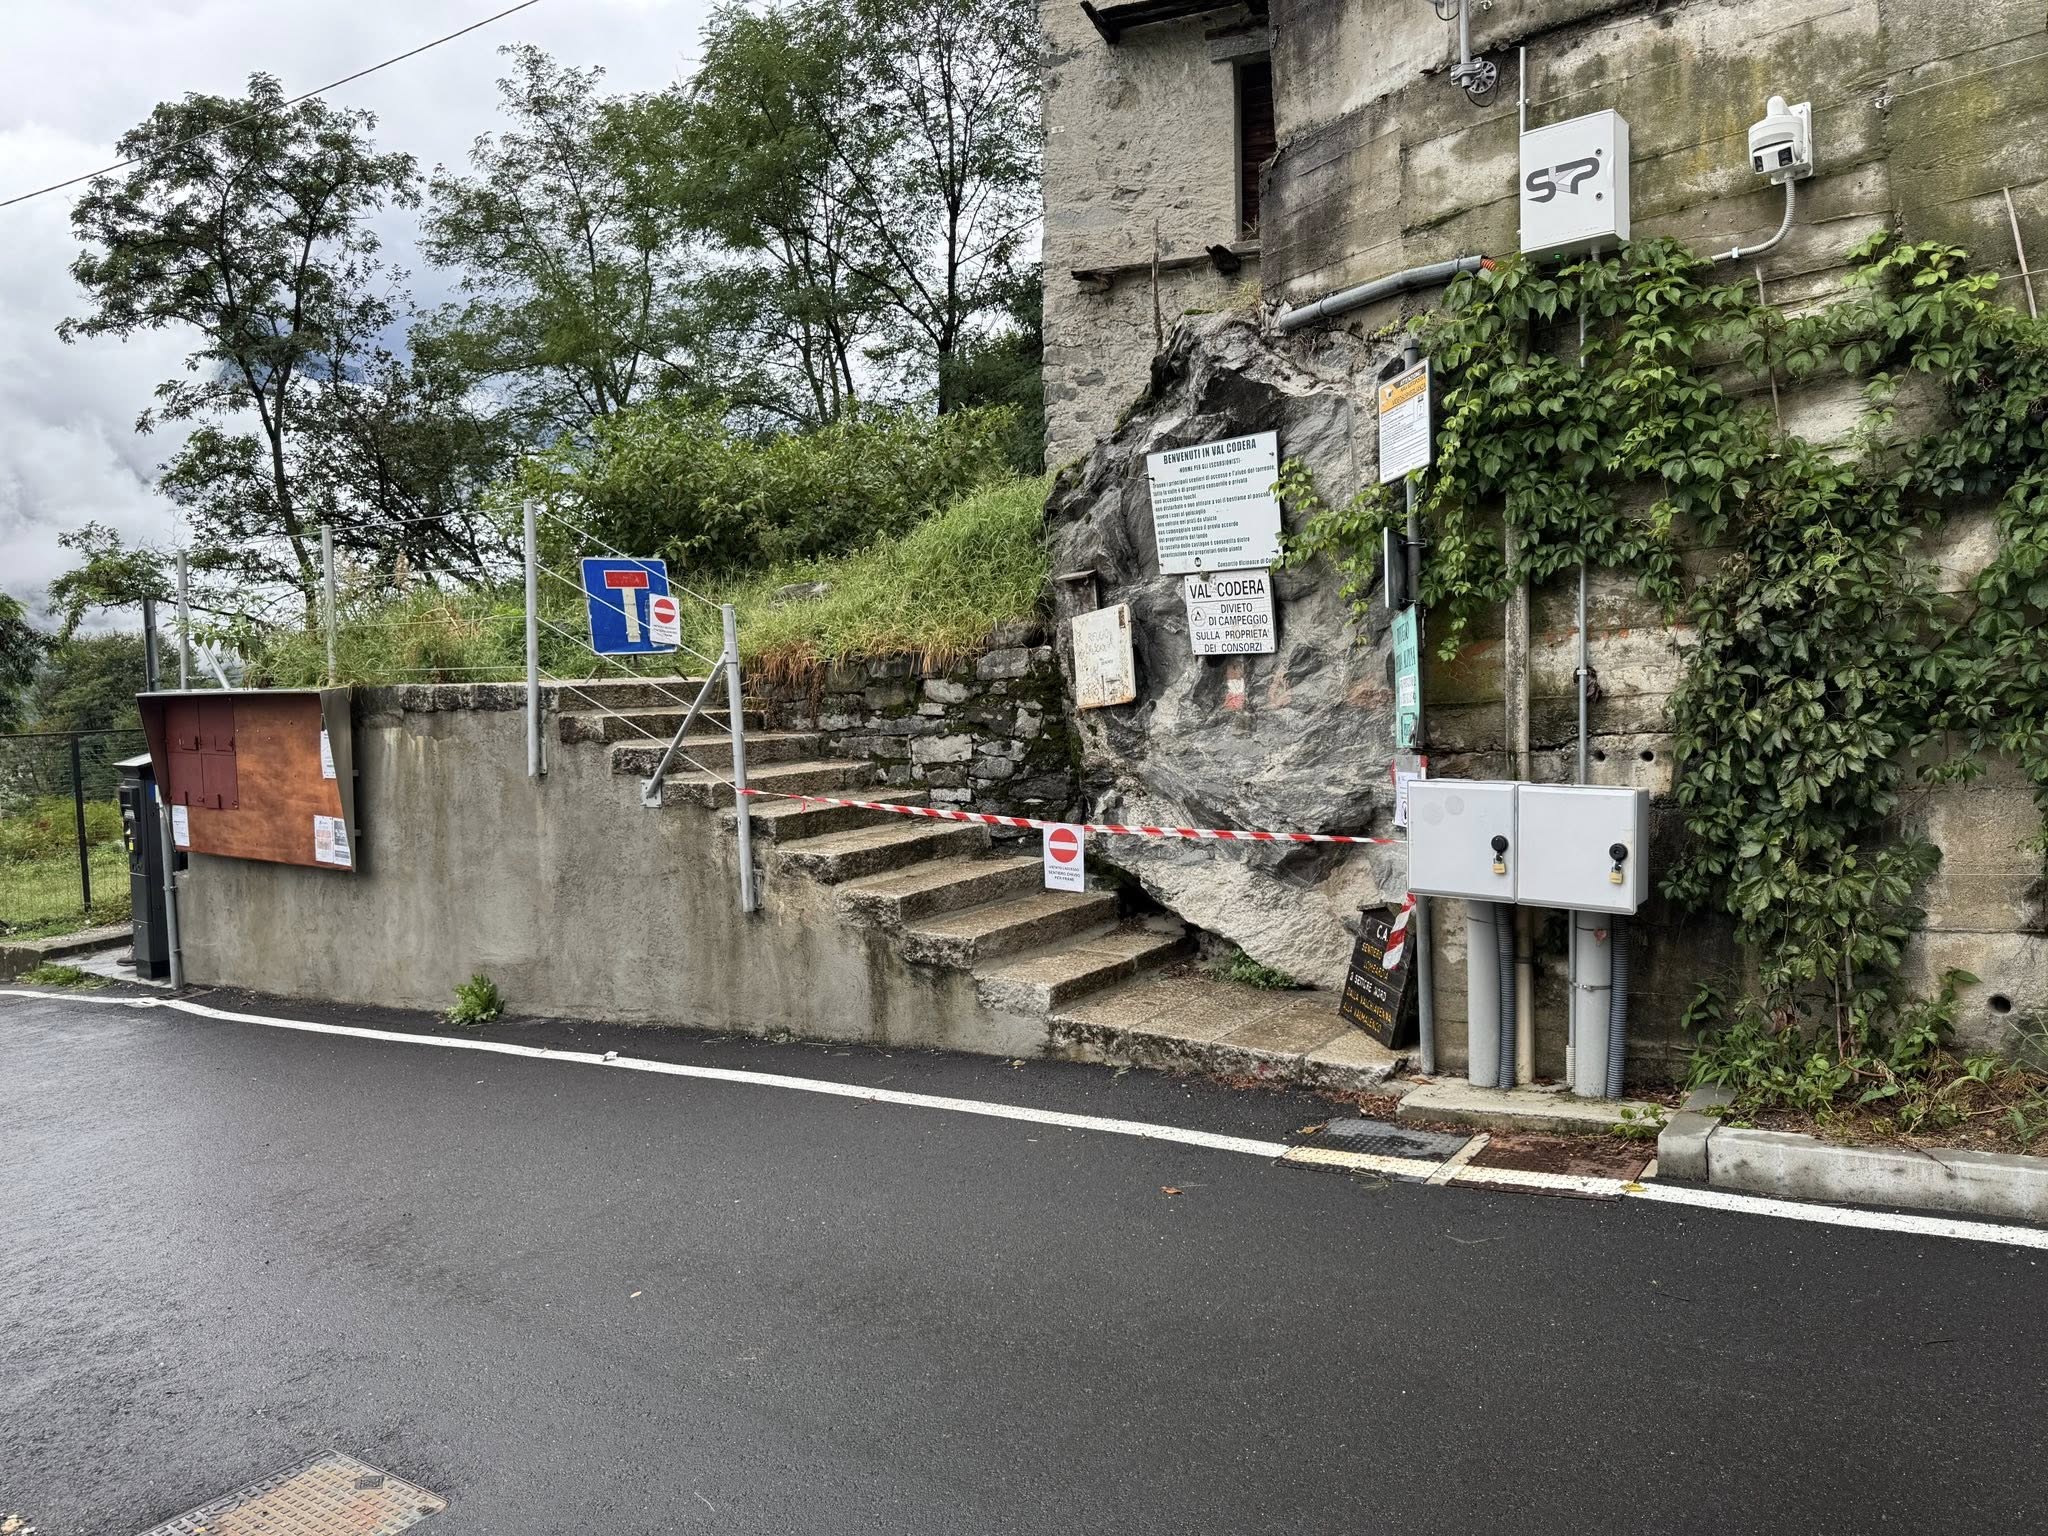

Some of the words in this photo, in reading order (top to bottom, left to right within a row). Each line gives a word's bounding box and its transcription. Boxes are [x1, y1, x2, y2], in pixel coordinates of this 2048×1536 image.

[1163, 449, 1200, 464] BENVENUTI
[1202, 447, 1210, 457] IN
[1212, 445, 1224, 455] VAL
[1226, 439, 1256, 453] CODERA
[1190, 584, 1211, 598] VAL
[1218, 579, 1264, 597] CODERA
[1221, 603, 1253, 613] DIVIETO
[1209, 617, 1216, 625] DI
[1219, 615, 1268, 625] CAMPEGGIO
[1196, 632, 1220, 640] SULLA
[1226, 629, 1269, 639] PROPRIETA'
[1205, 644, 1216, 652] DEI
[1222, 643, 1262, 652] CONSORZI
